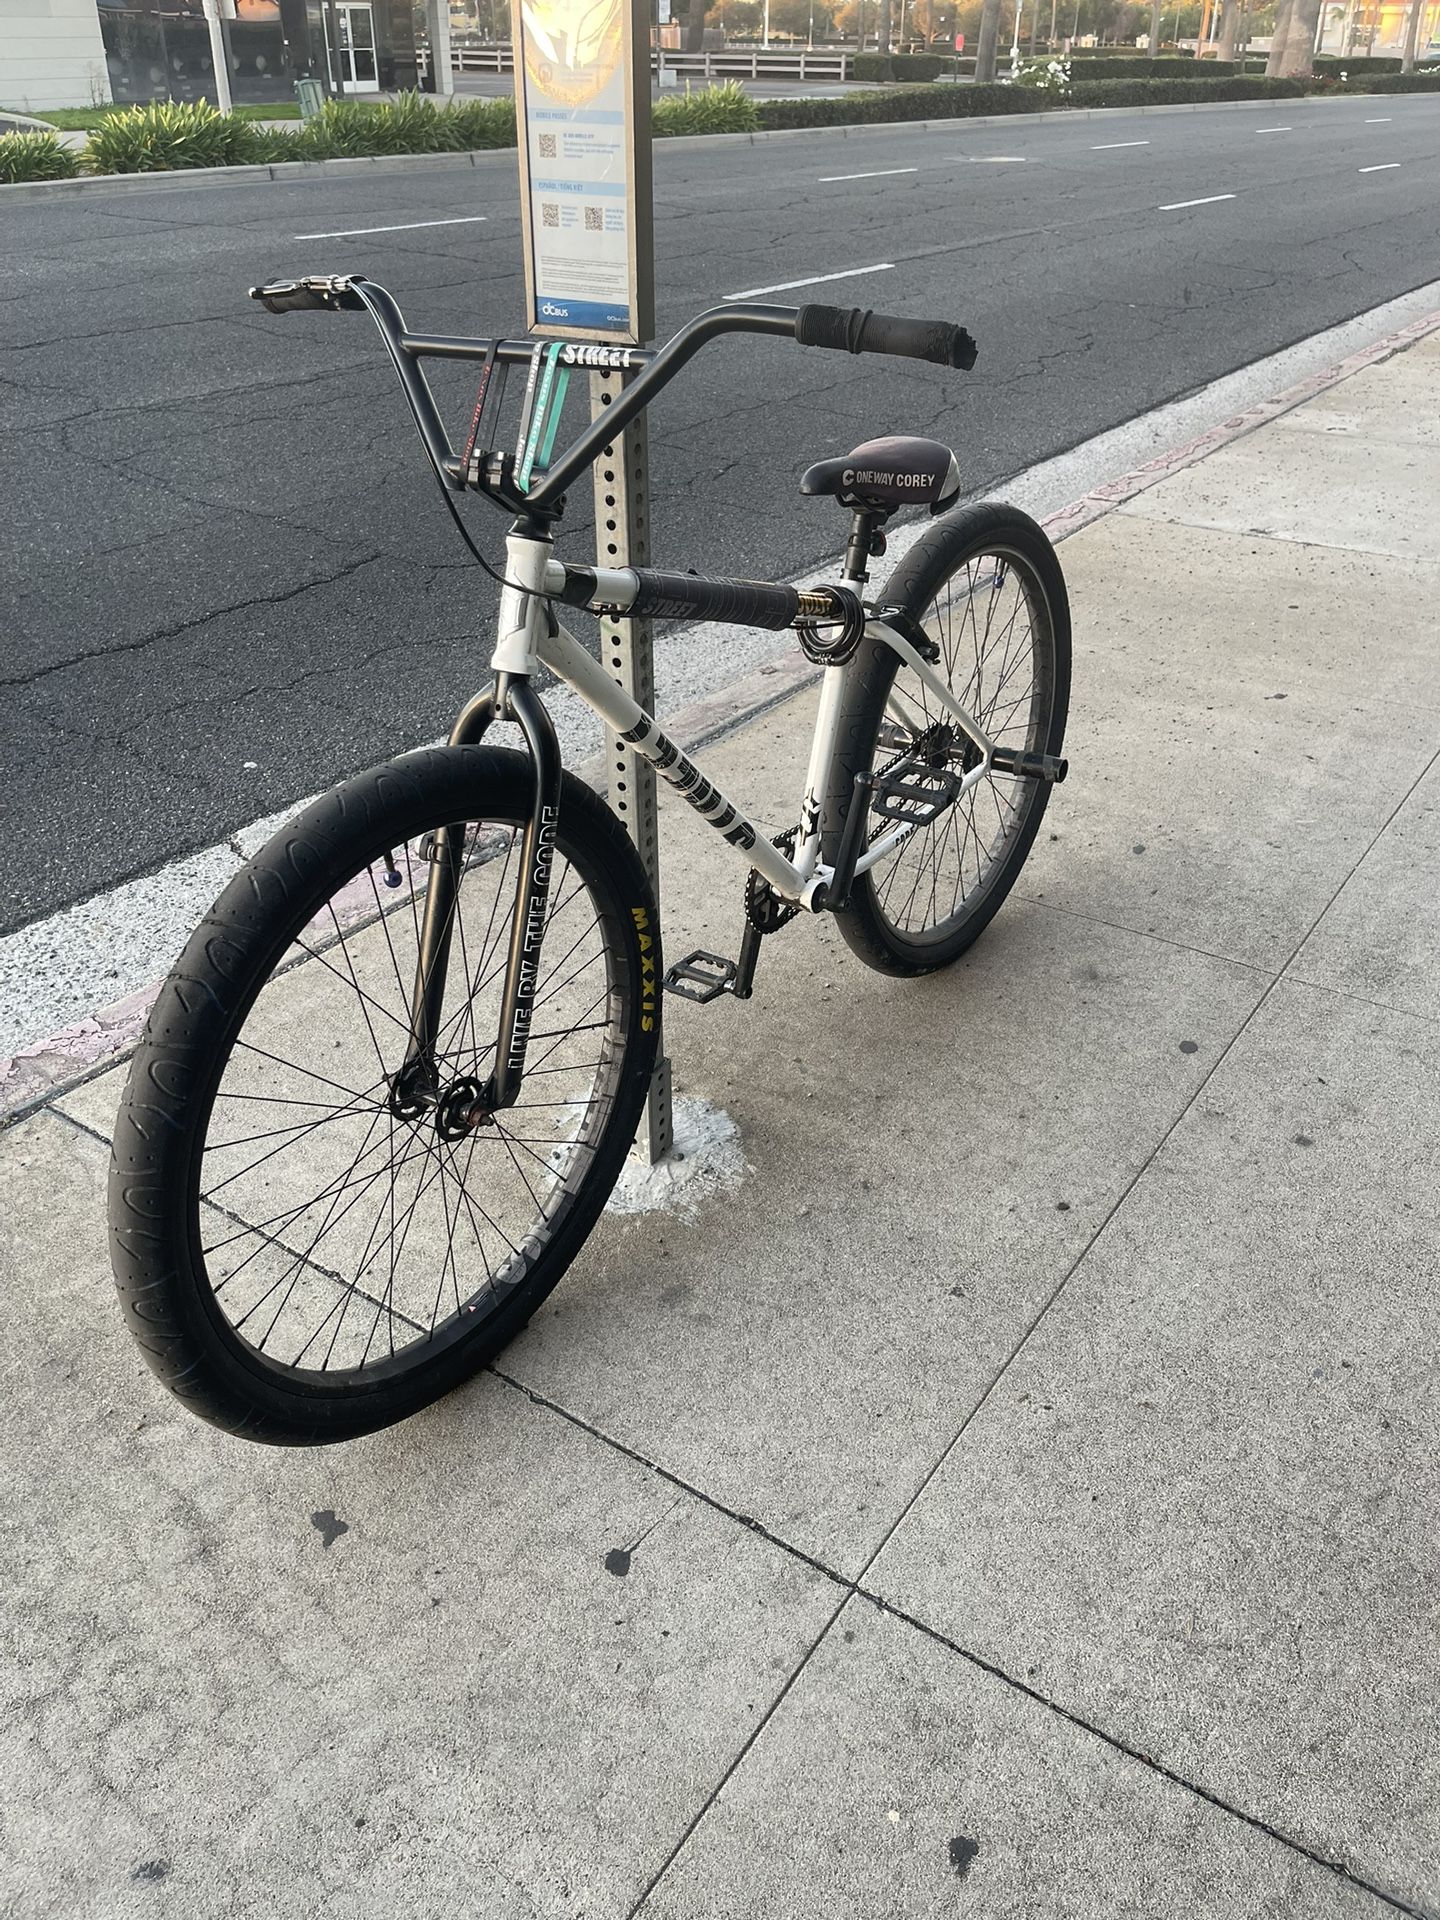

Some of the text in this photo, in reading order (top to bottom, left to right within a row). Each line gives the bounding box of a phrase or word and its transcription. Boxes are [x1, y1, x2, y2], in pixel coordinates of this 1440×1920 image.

[563, 344, 633, 368] STREET
[896, 474, 936, 487] COREY
[642, 597, 698, 617] STREET
[523, 896, 548, 953] THE
[632, 907, 655, 1032] MAXXIS
